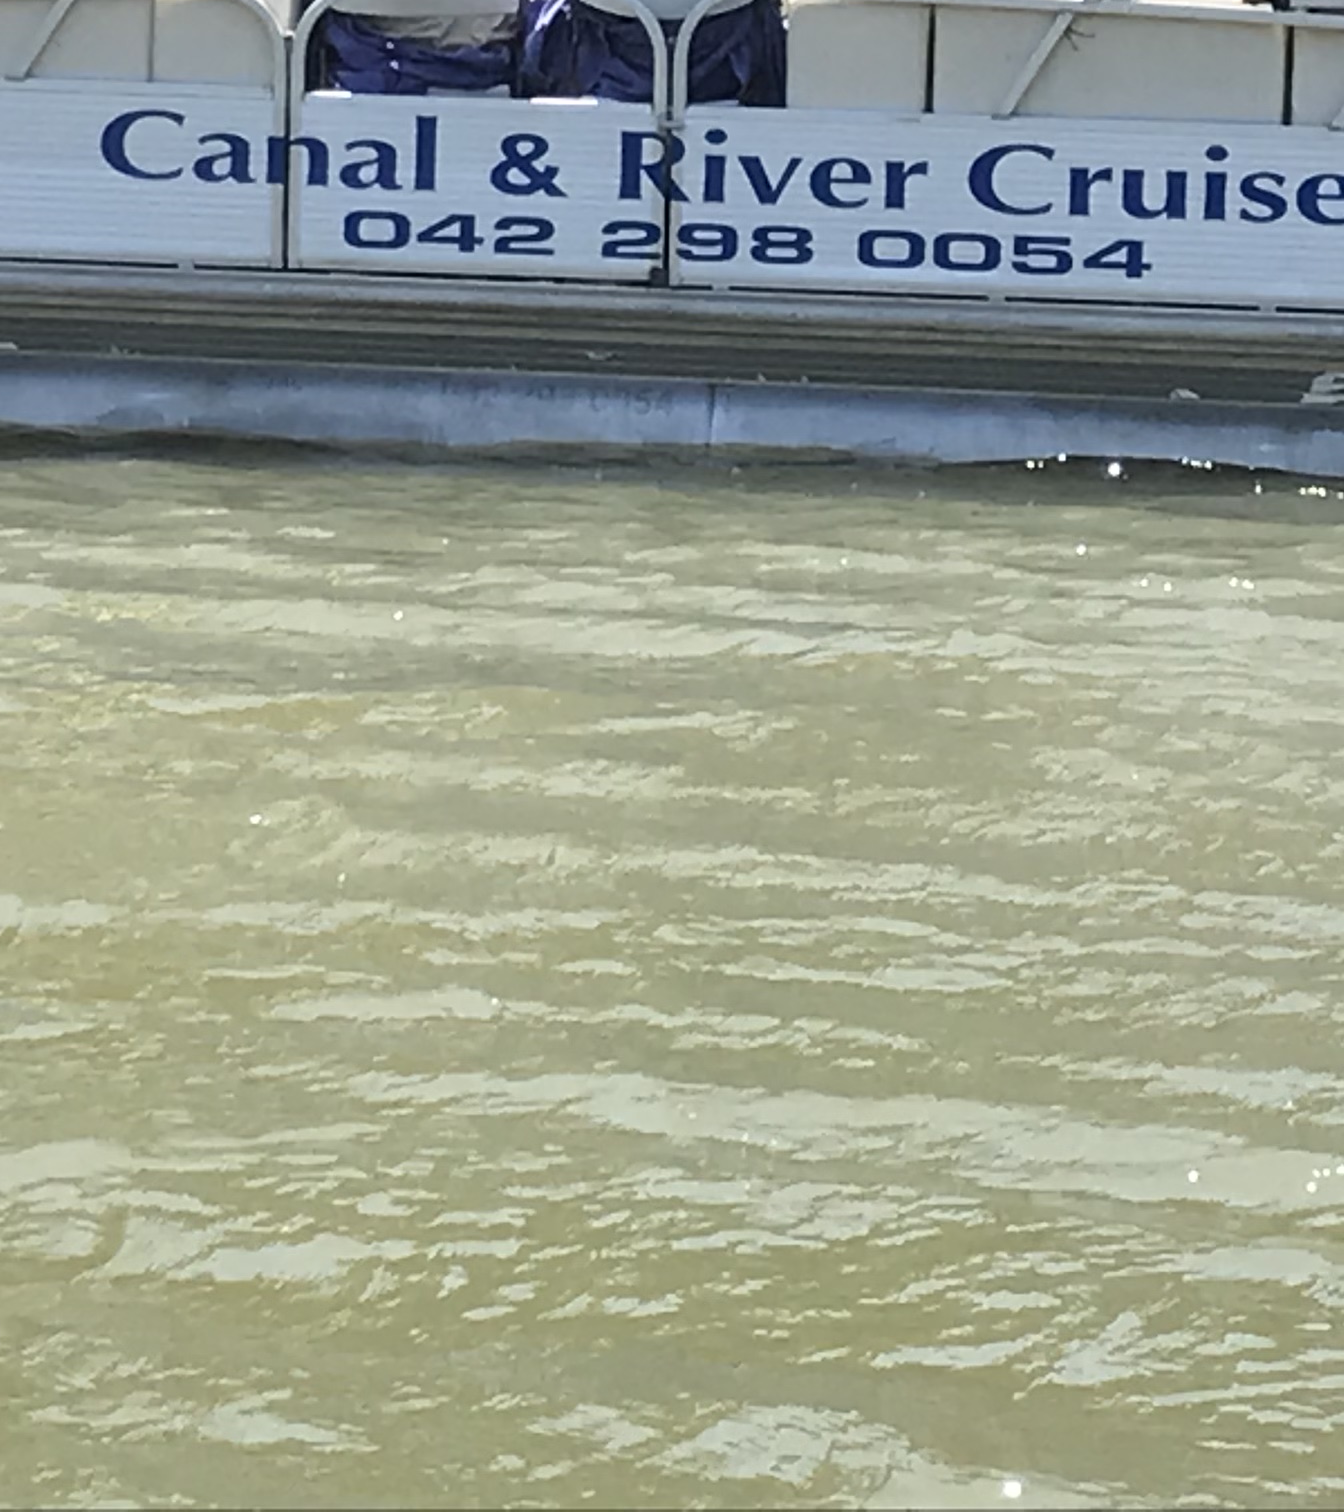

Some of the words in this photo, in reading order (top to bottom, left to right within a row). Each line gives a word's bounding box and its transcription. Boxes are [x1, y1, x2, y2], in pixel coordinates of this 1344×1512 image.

[99, 109, 439, 191] Canal
[488, 132, 568, 198] &
[618, 129, 930, 209] River
[342, 210, 556, 255] 042
[600, 221, 815, 265] 298
[855, 230, 1153, 279] 0054
